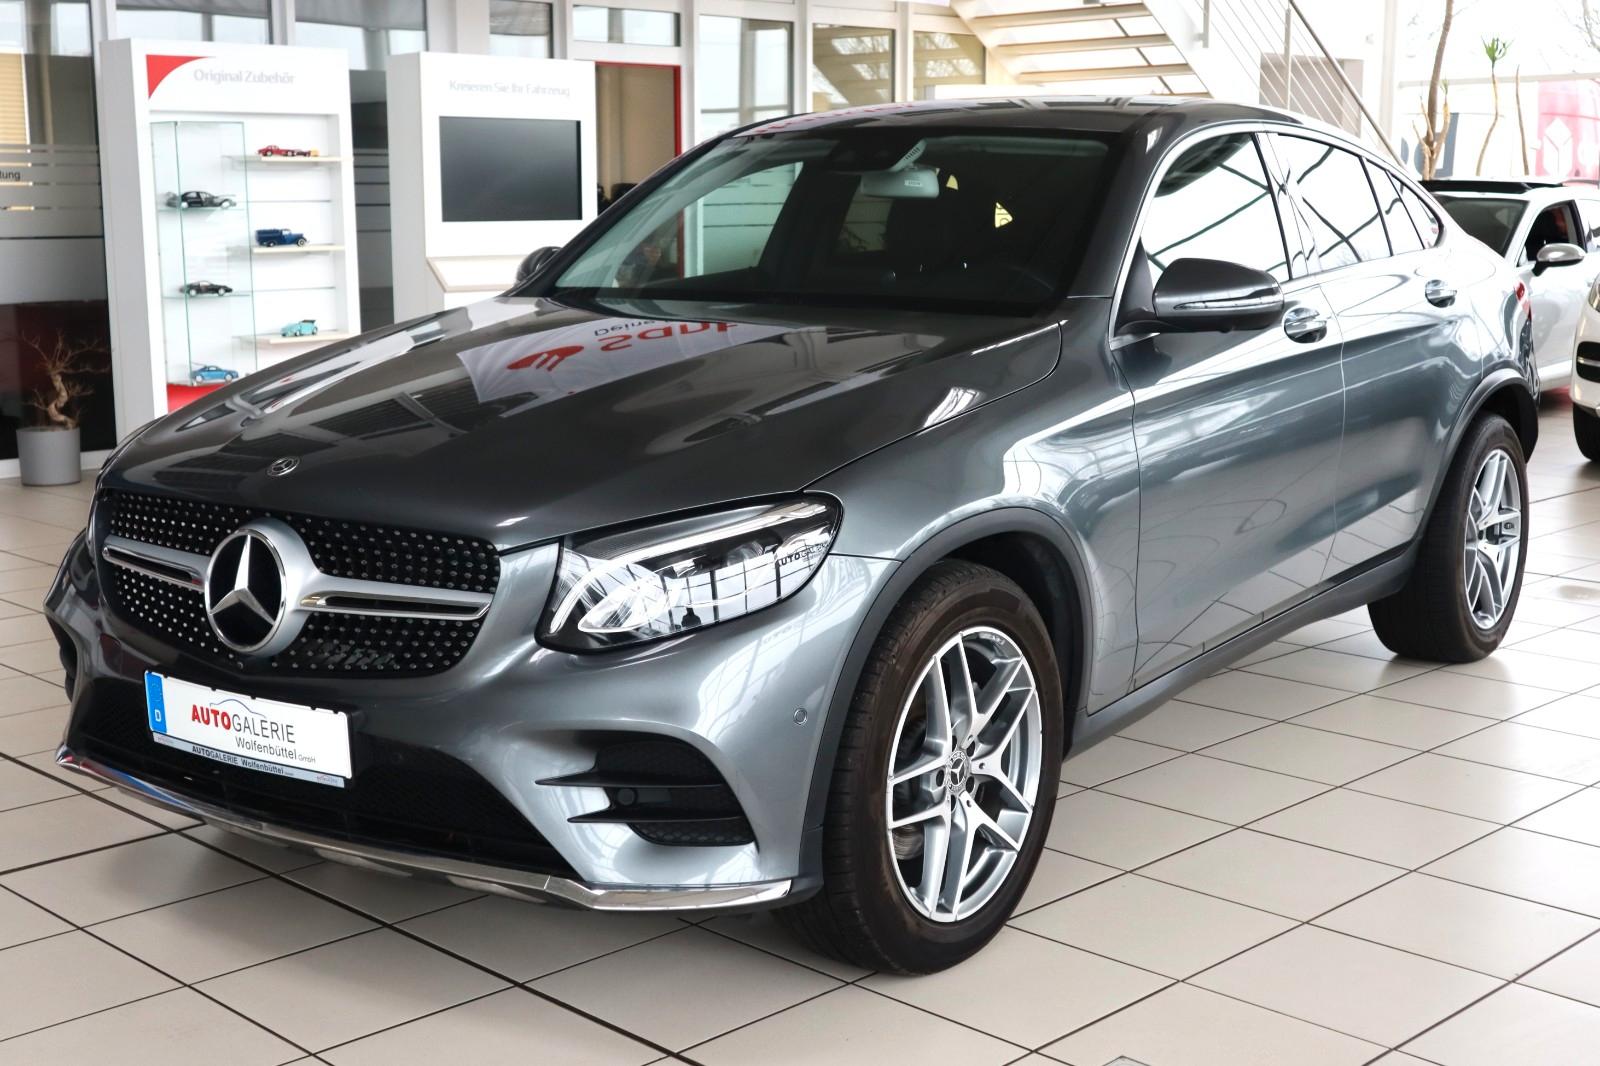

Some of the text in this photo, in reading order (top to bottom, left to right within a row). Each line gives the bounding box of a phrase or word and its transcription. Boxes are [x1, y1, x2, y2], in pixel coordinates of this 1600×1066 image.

[193, 68, 243, 85] Original
[154, 709, 161, 722] D
[191, 704, 296, 744] AUTOGALERIE
[192, 745, 284, 775] AUTOGALERIE Wolfenbüttel
[235, 736, 317, 764] Wolfenbüttel GmbH
